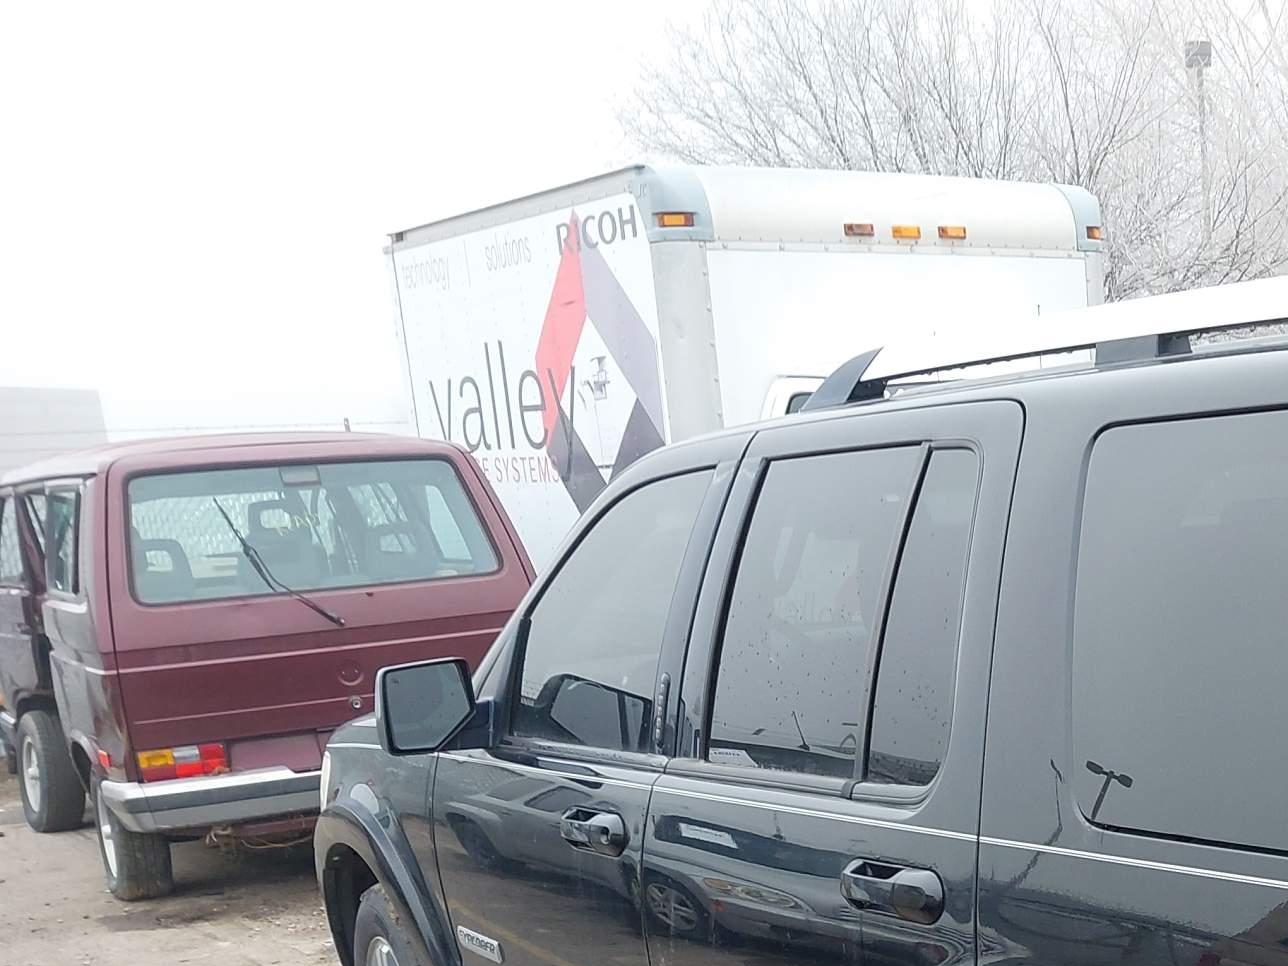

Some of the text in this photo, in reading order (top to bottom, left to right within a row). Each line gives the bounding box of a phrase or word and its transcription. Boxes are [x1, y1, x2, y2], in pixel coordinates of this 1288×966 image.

[485, 232, 532, 272] solutions
[556, 204, 638, 256] RICOH
[428, 338, 576, 483] valley
[494, 454, 561, 484] SYSTEMS
